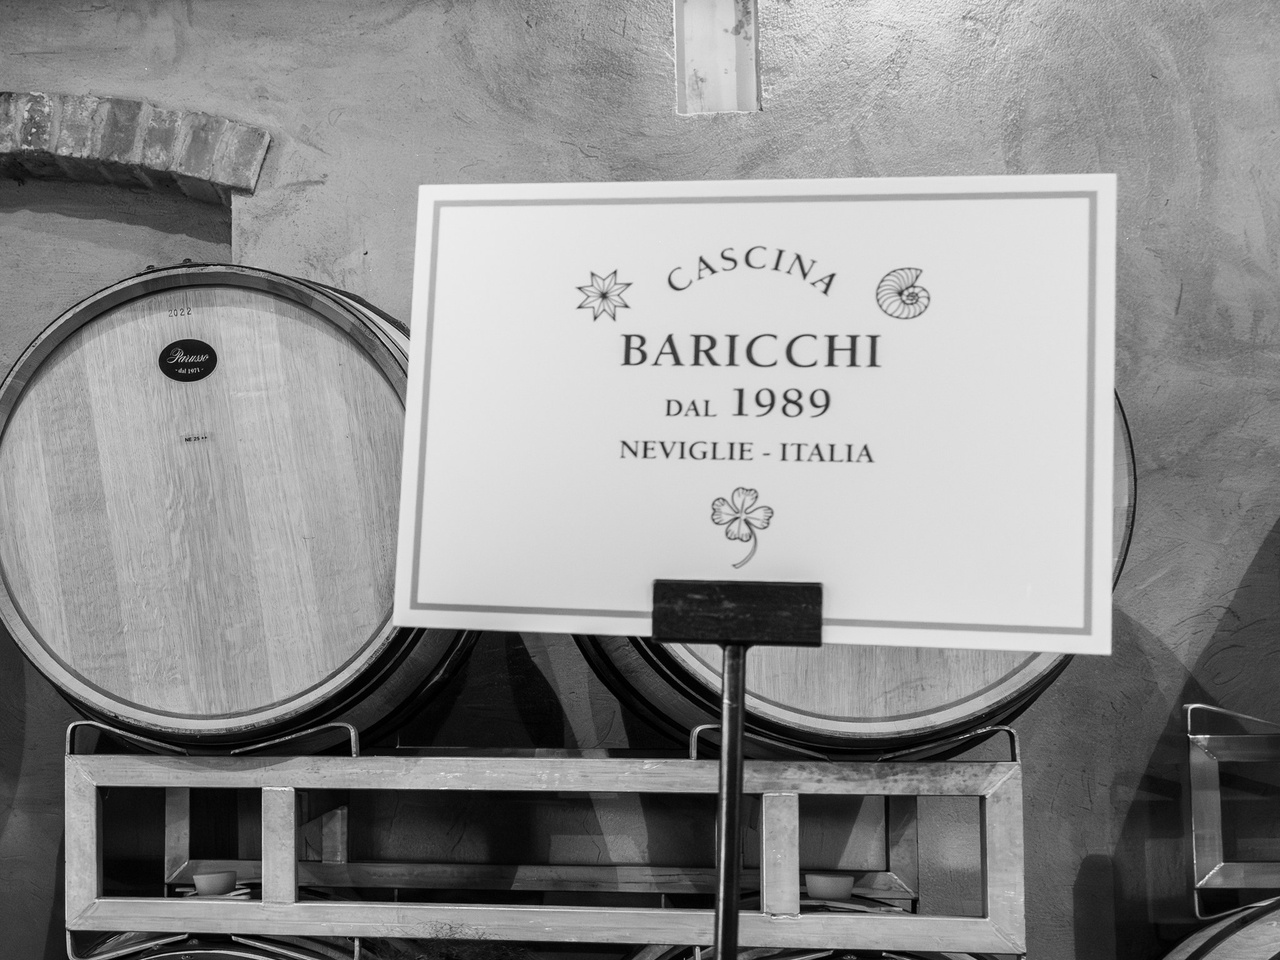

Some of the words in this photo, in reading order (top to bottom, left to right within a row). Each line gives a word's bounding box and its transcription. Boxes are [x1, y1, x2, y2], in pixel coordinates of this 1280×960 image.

[667, 245, 837, 297] CASCINA
[169, 307, 192, 317] 2022
[166, 347, 209, 364] Parusso
[620, 333, 882, 369] BARICCHI
[665, 399, 717, 418] DAL
[732, 387, 832, 419] 1989
[620, 440, 754, 462] NEVIGLIE
[780, 442, 875, 464] ITALIA
